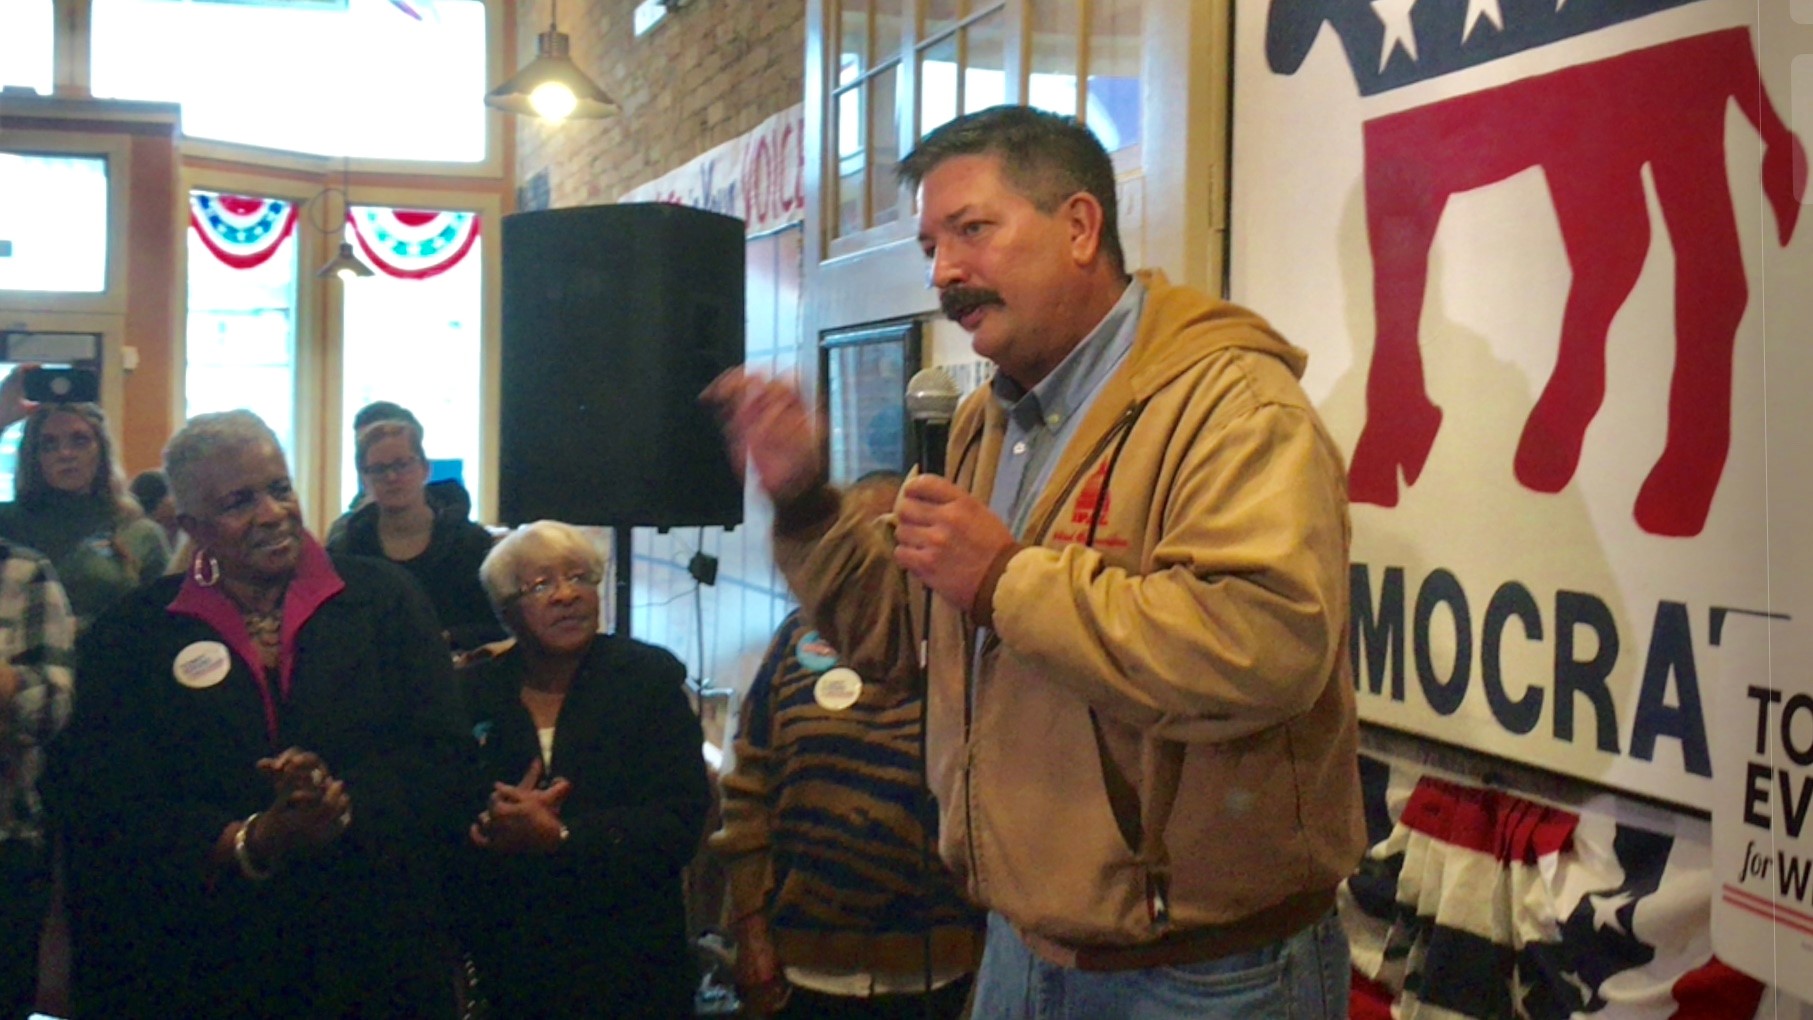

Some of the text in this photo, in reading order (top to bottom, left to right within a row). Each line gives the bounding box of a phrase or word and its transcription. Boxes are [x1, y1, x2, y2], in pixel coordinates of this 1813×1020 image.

[1349, 563, 1790, 778] MOCRA
[1739, 840, 1813, 906] for W
